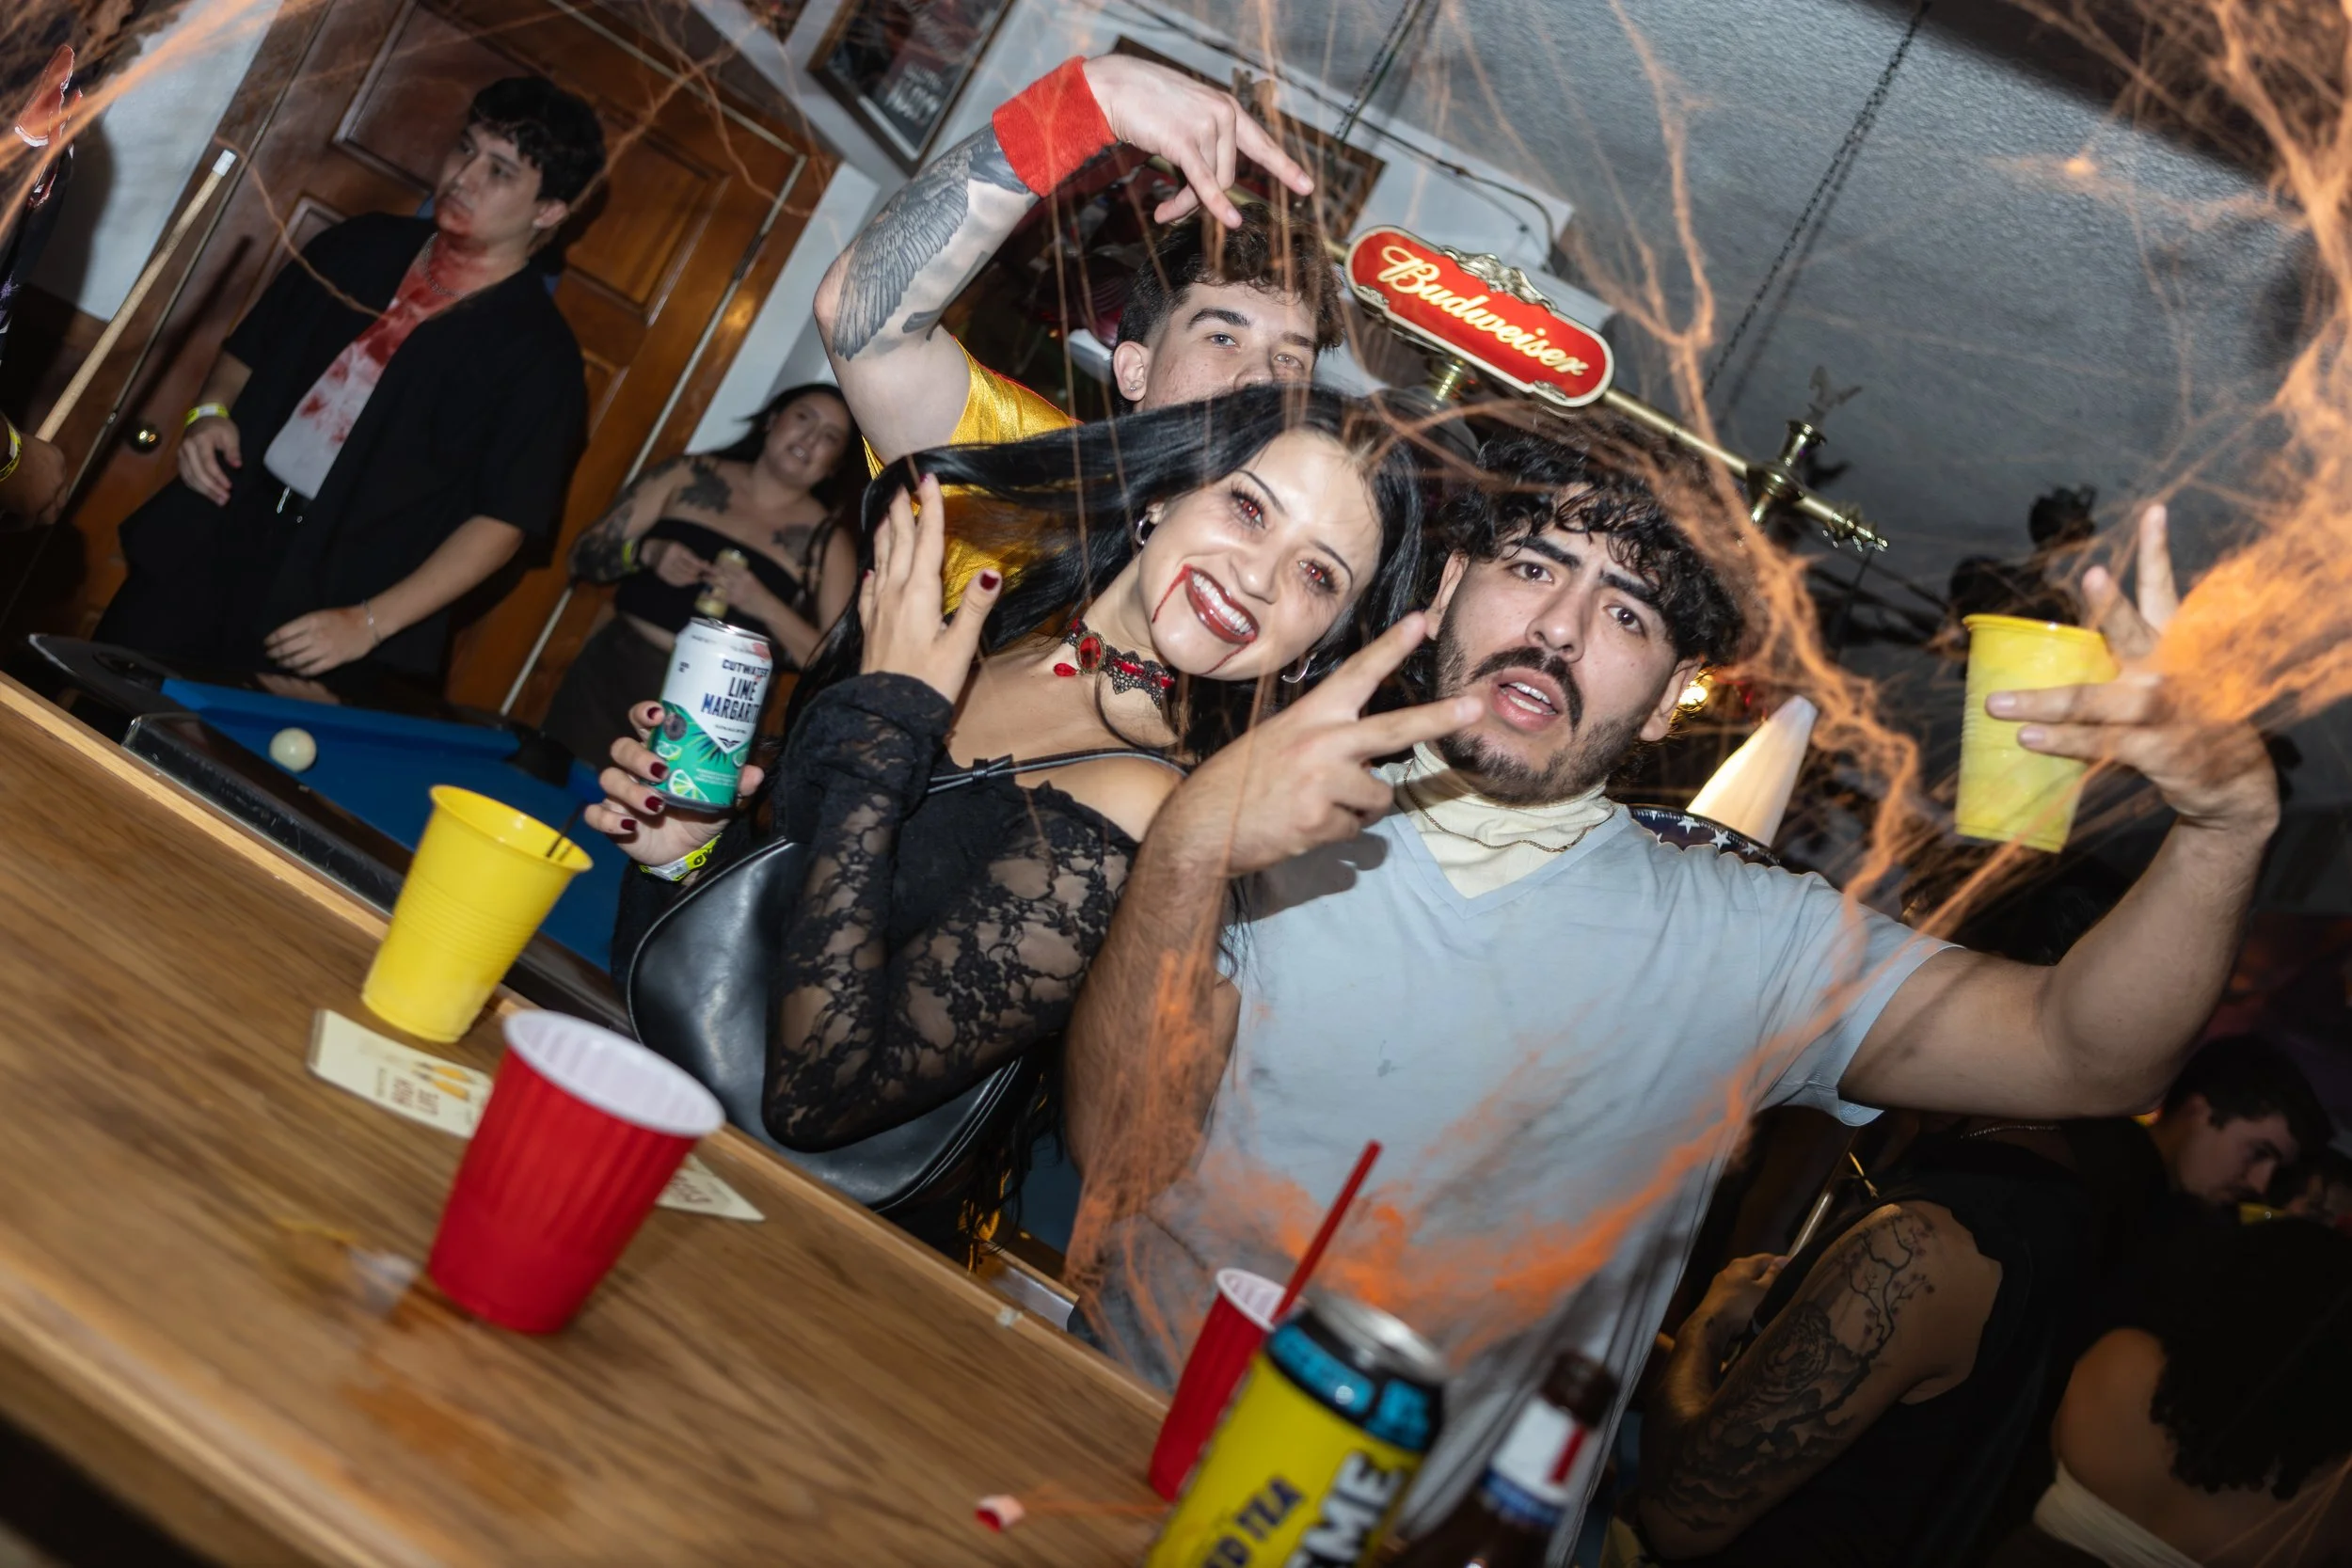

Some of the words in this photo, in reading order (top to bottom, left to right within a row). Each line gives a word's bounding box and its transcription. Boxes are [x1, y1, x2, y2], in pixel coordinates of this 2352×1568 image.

[1377, 245, 1590, 377] Budweiser
[728, 676, 758, 702] LIME
[1234, 1473, 1306, 1544] TEA
[1285, 1449, 1404, 1568] ME
